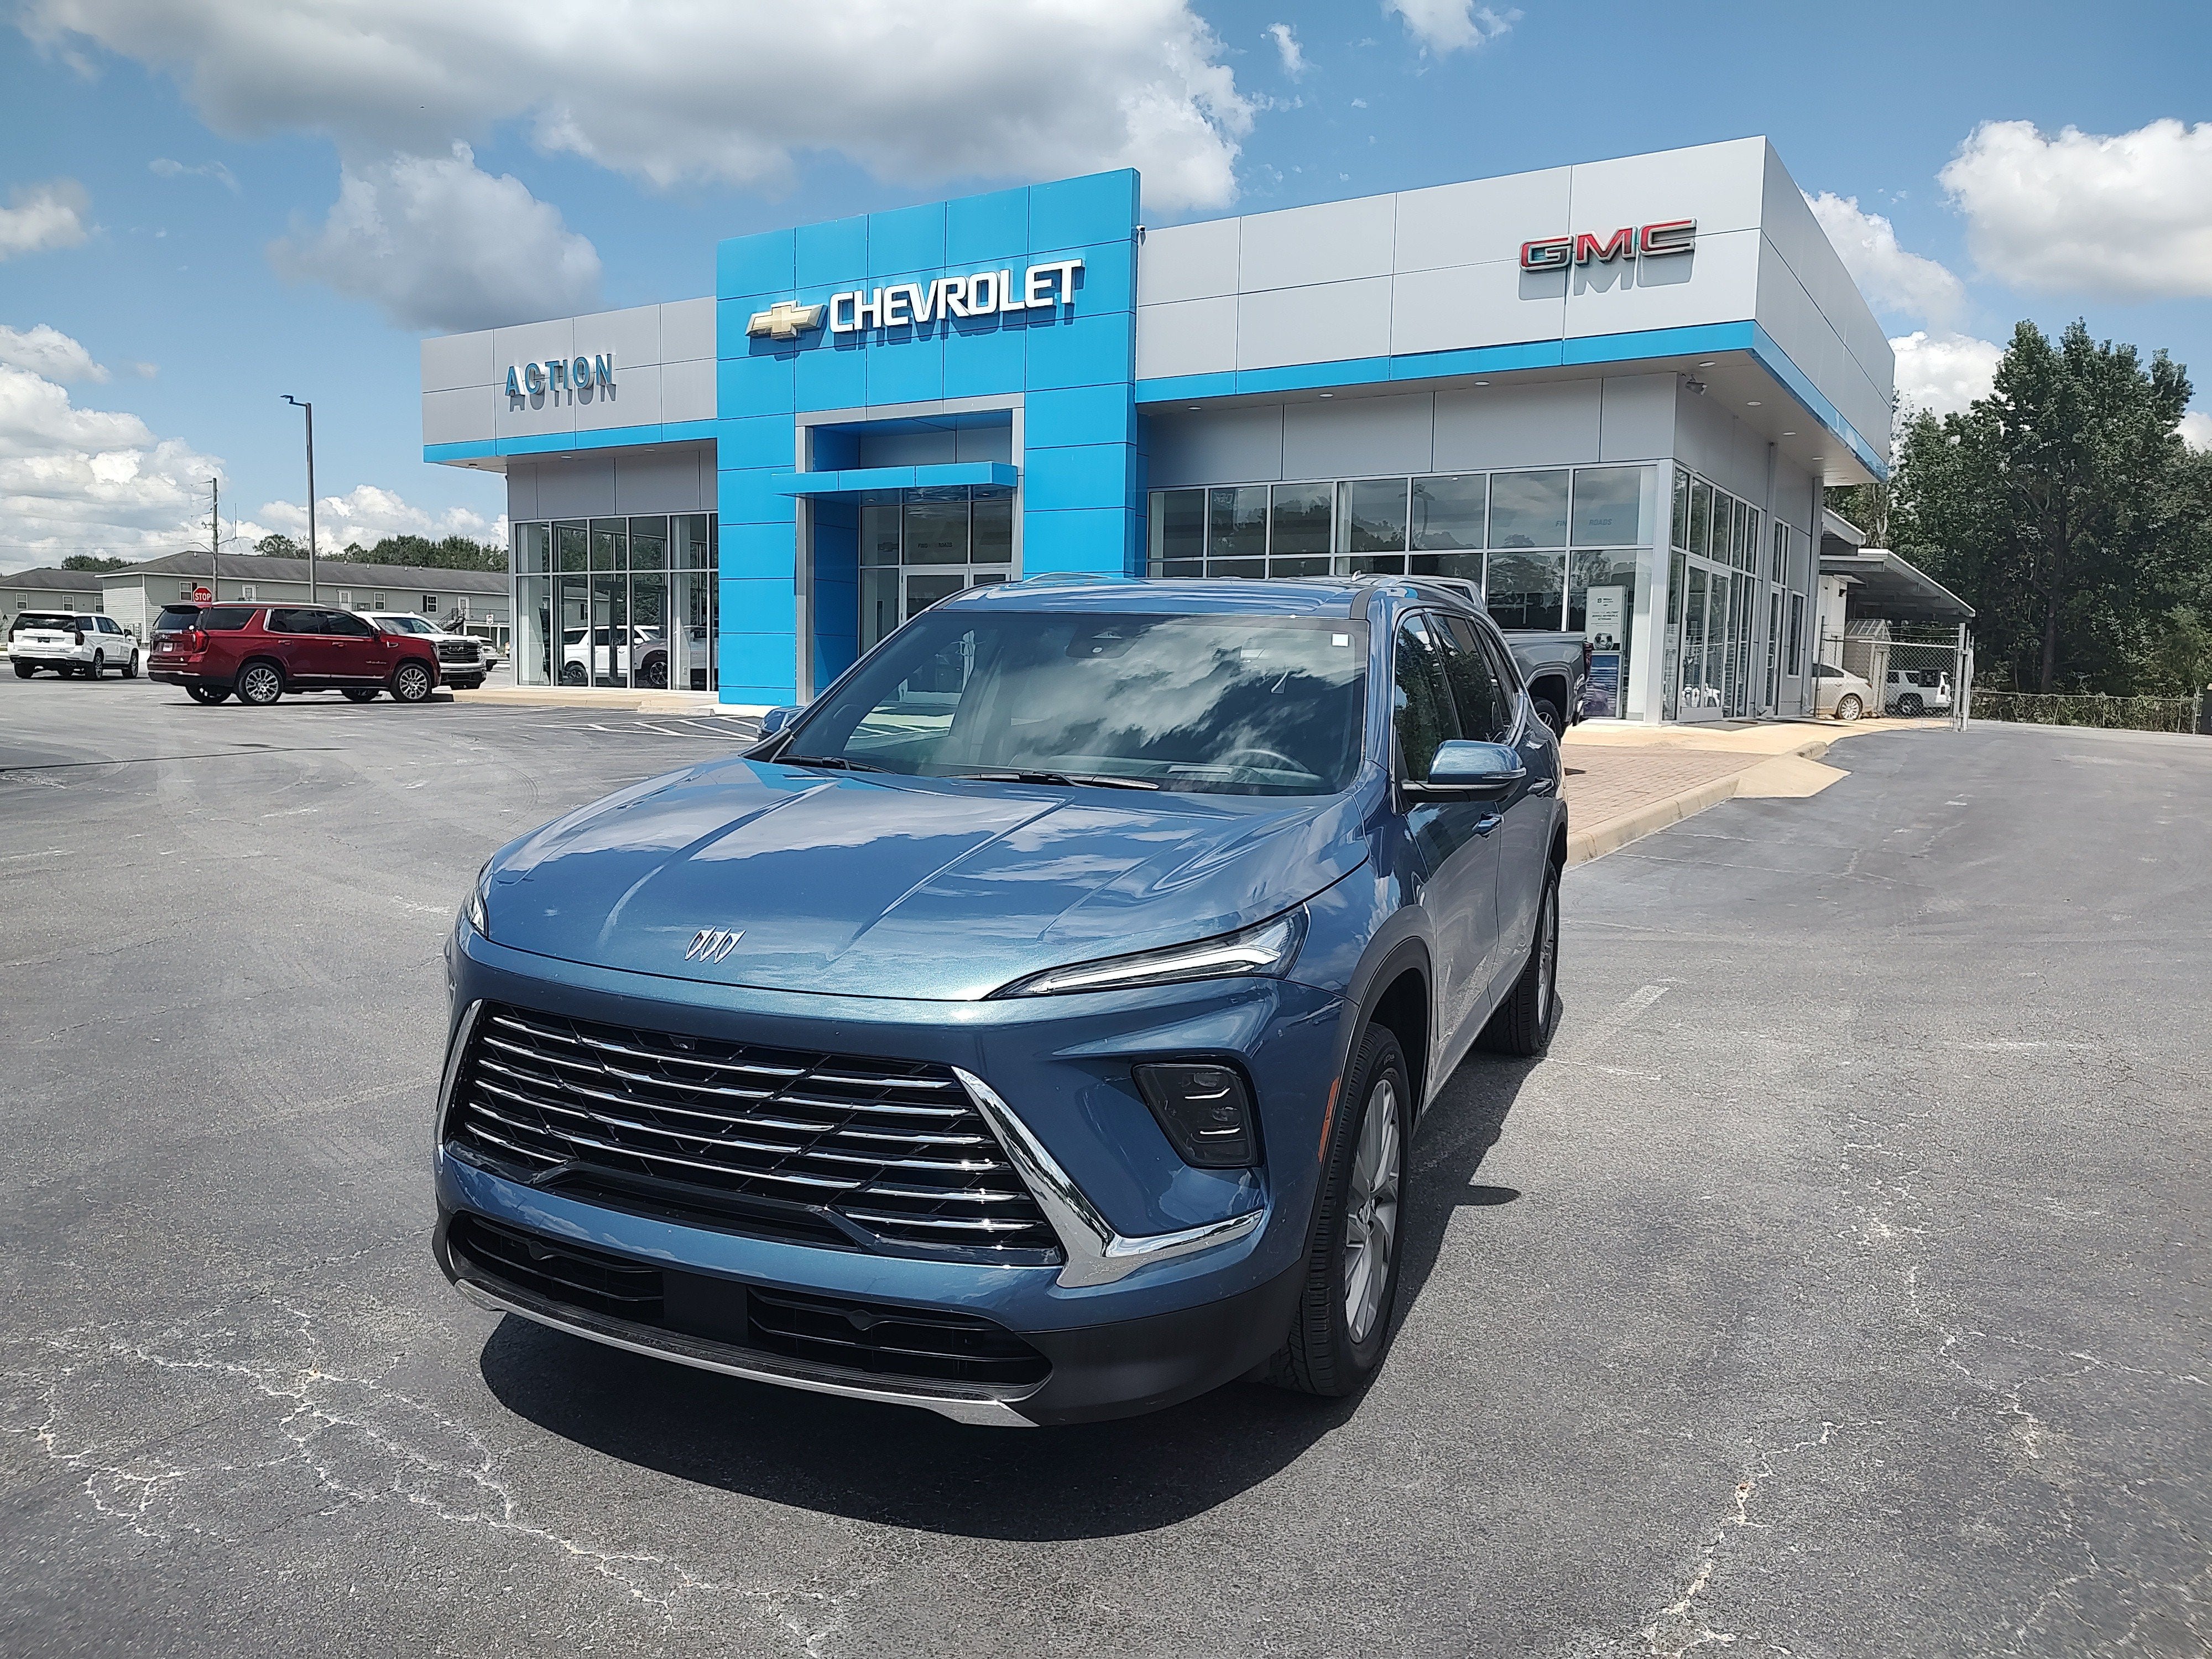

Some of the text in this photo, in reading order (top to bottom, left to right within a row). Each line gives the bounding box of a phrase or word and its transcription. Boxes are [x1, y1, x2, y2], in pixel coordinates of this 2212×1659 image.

[1519, 217, 1697, 272] GMC
[830, 259, 1082, 332] CHEVROLET
[505, 354, 614, 396] ACTION
[195, 592, 211, 601] STOP
